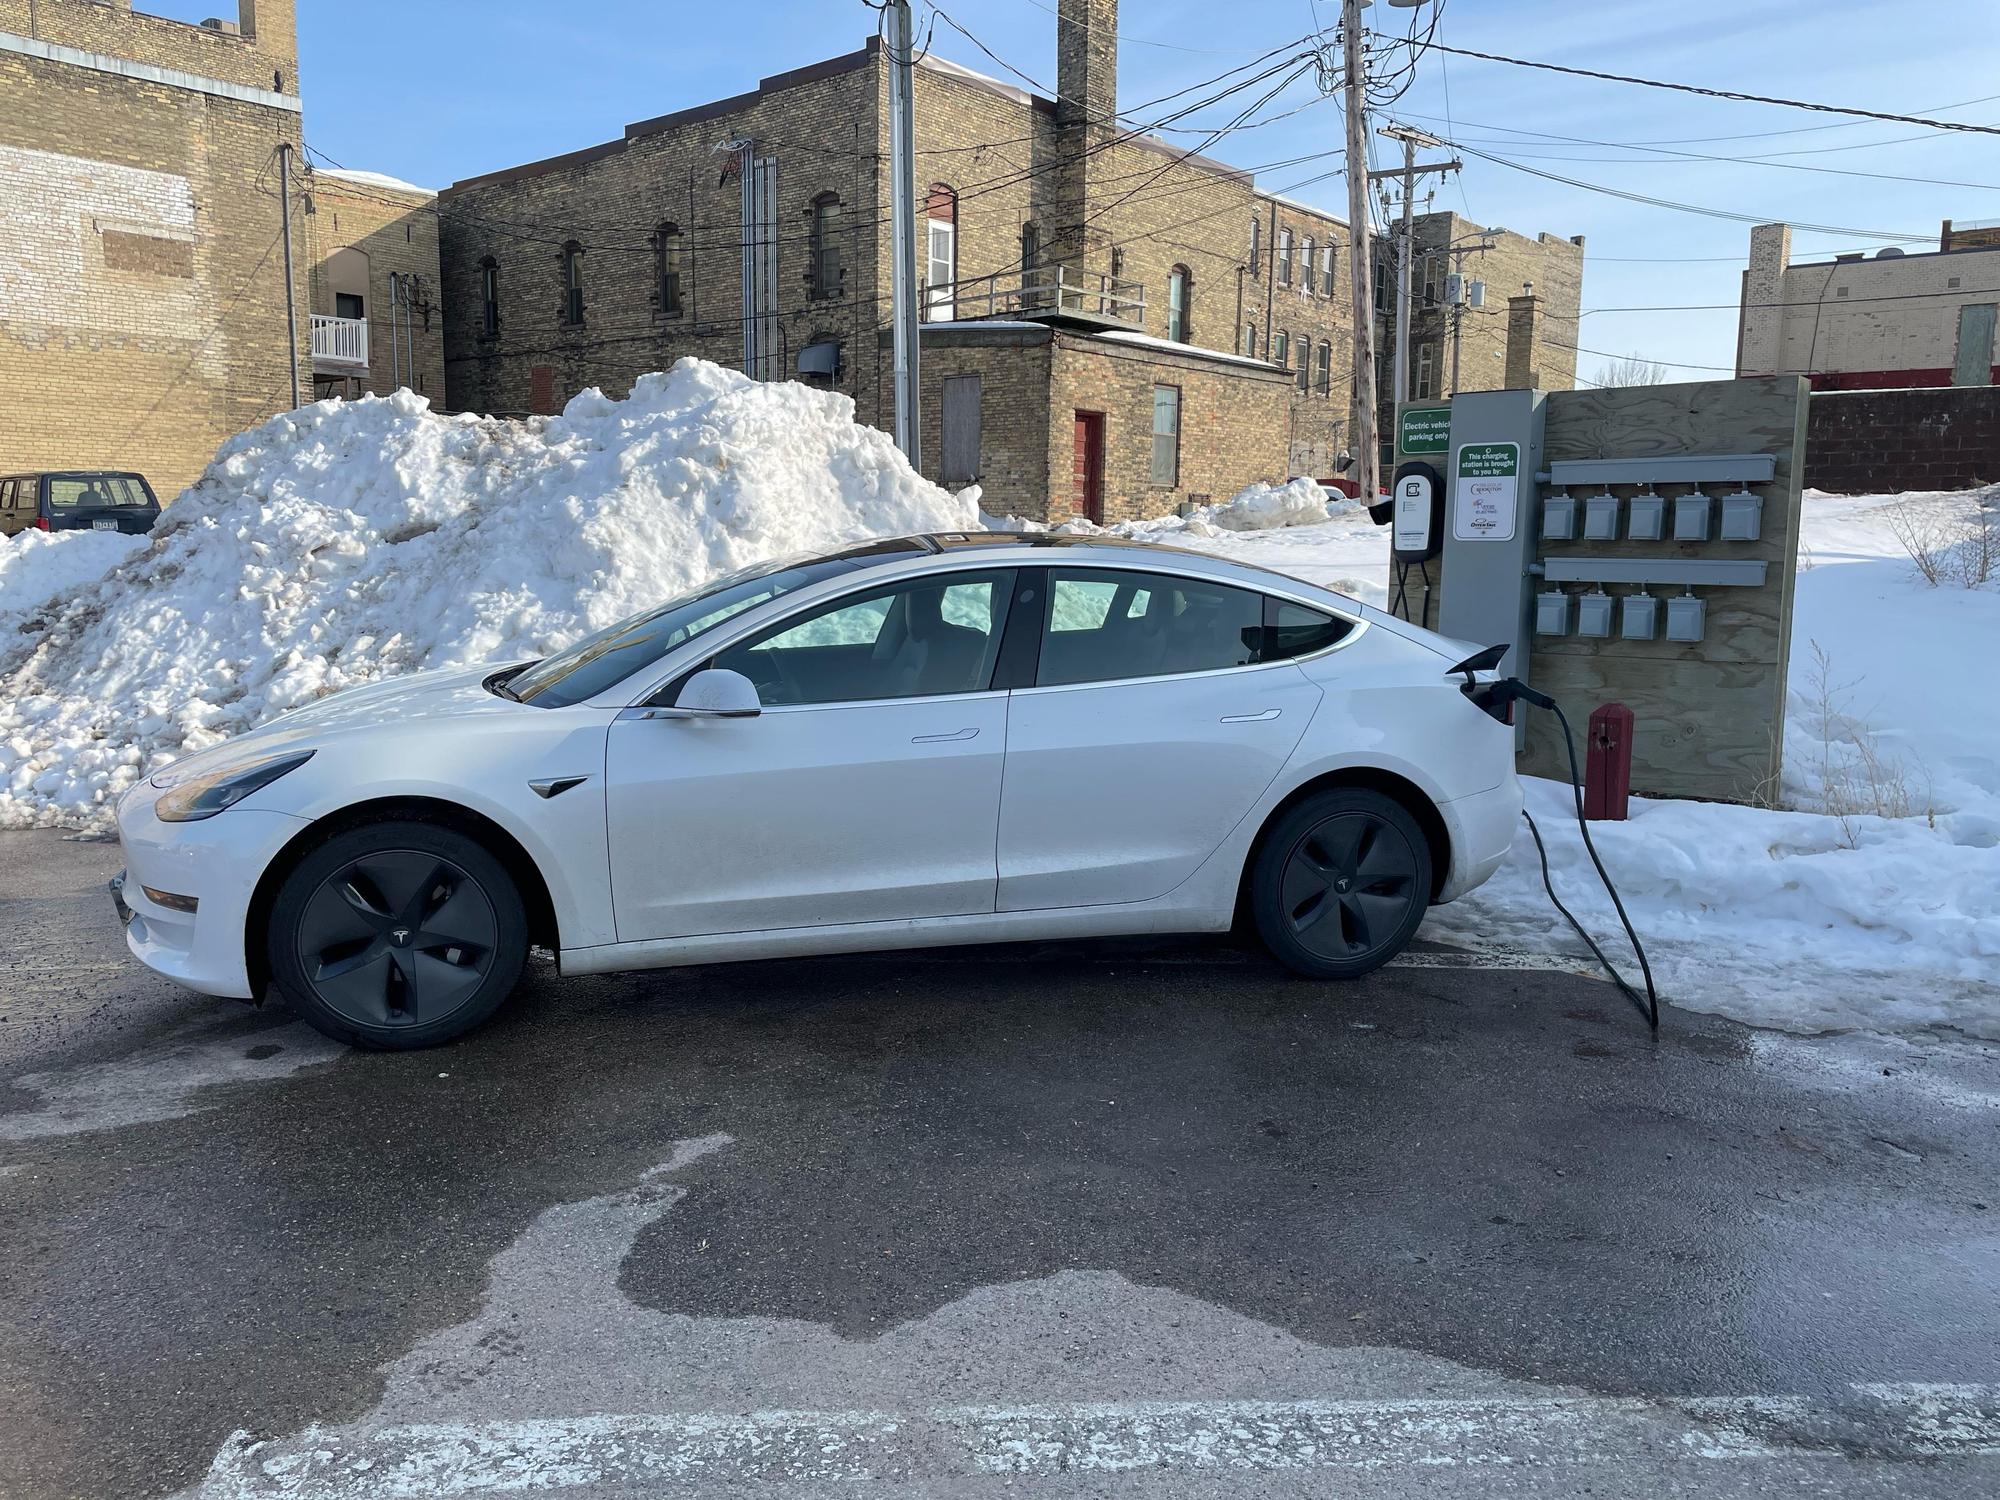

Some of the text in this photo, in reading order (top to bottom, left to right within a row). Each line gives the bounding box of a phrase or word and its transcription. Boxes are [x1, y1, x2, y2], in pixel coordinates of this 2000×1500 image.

[1405, 421, 1451, 430] Electric vehicl
[1409, 432, 1448, 442] parking only
[1482, 452, 1509, 461] charging
[1491, 460, 1514, 468] brought
[1493, 468, 1502, 476] by:
